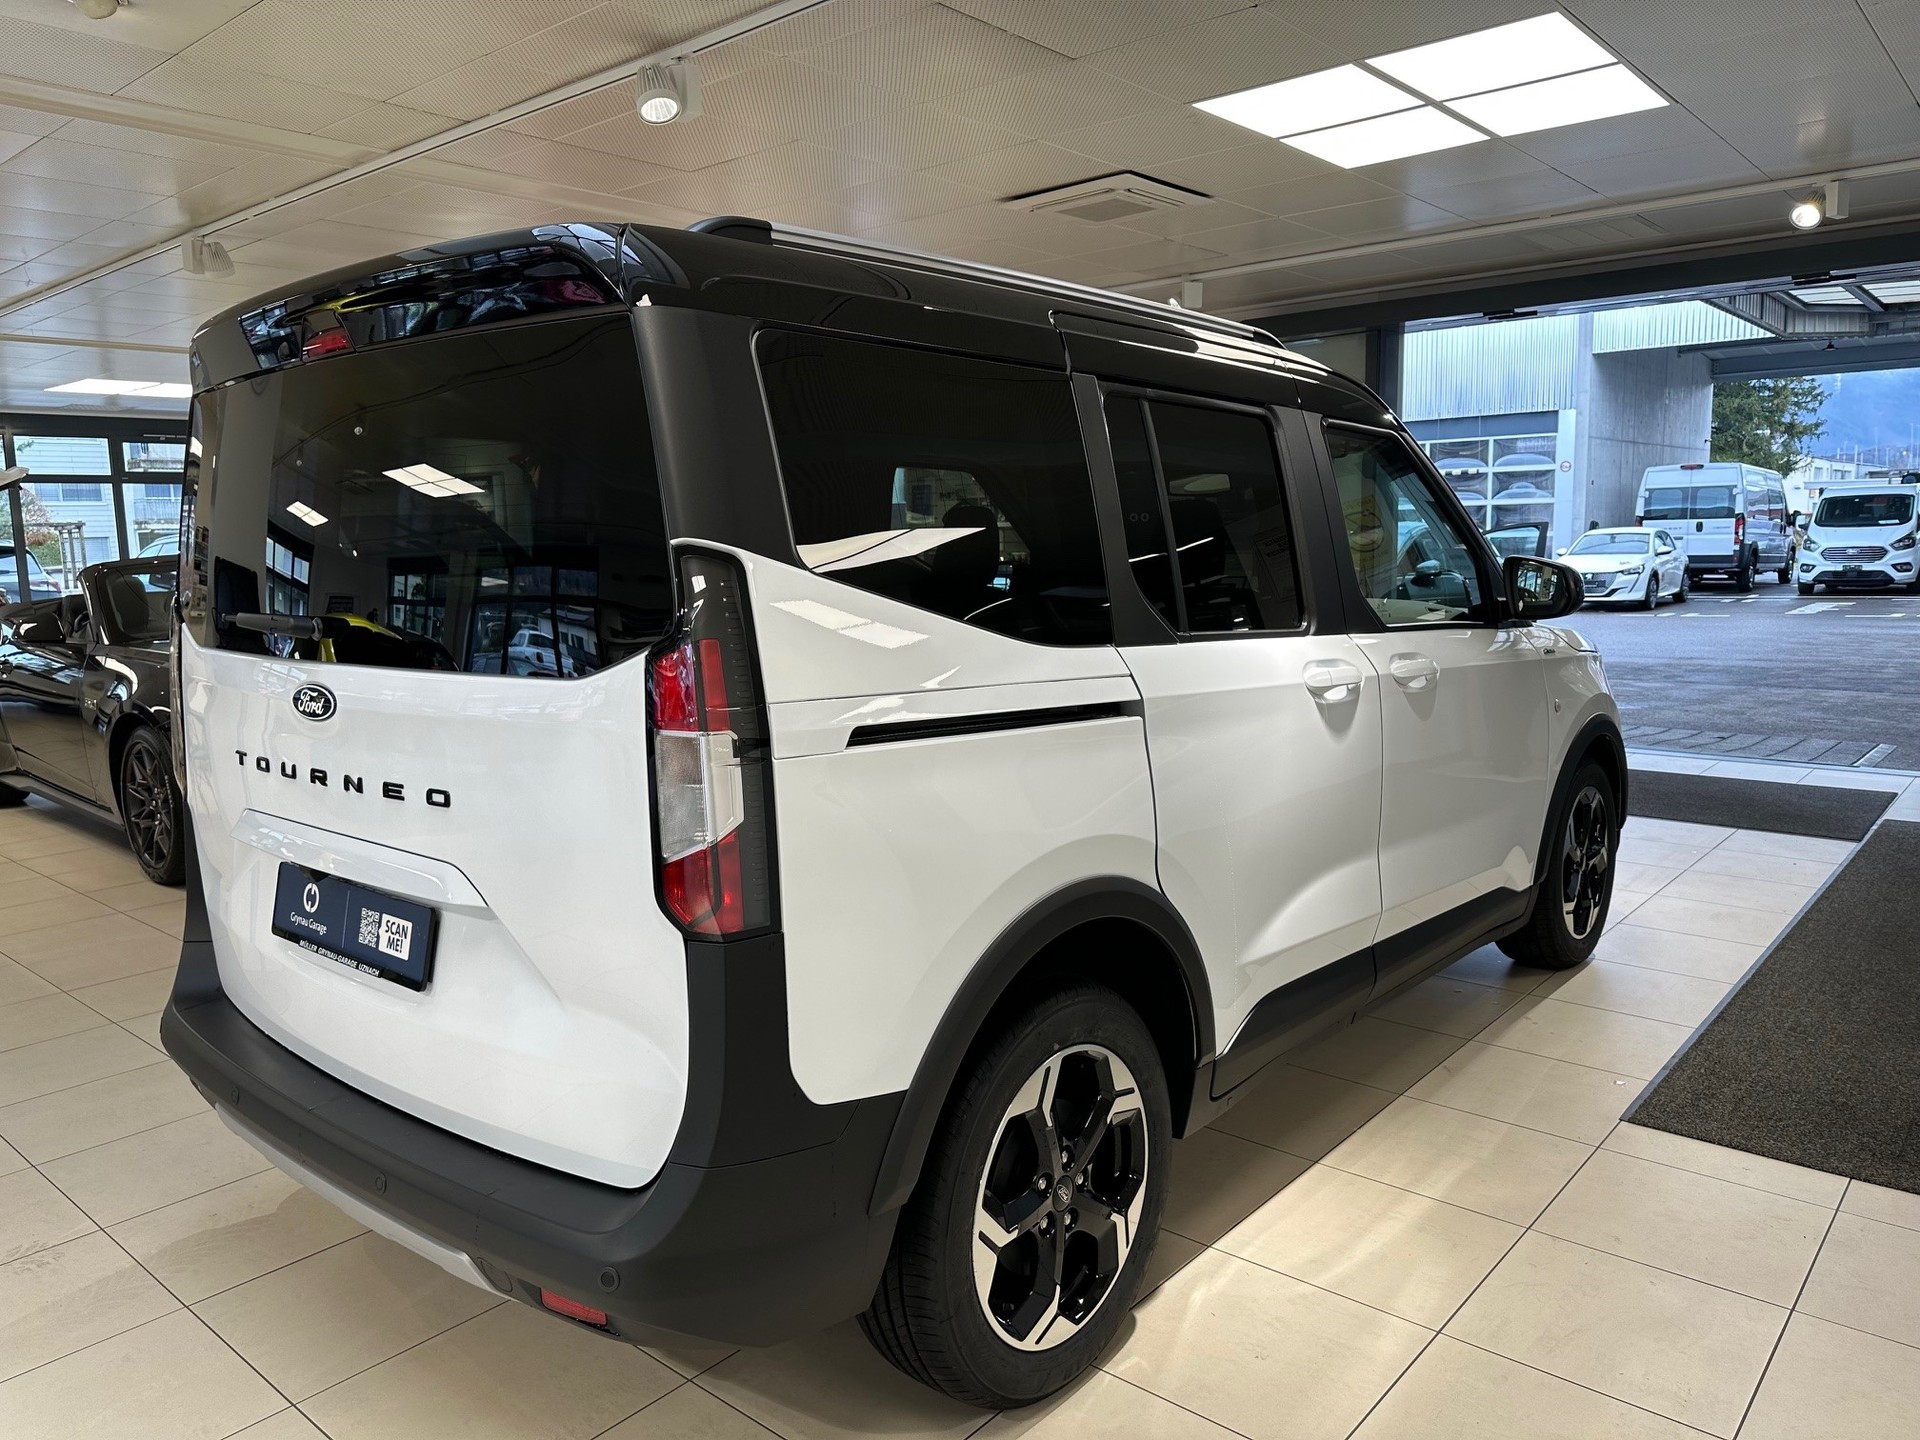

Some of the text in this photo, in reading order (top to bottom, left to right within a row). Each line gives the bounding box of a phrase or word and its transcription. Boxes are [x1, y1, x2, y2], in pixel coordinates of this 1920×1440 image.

[298, 689, 325, 716] Ford
[235, 749, 452, 808] TOURNEO
[290, 911, 328, 934] Grynau Garage
[385, 919, 409, 939] SCAN
[299, 939, 318, 953] MÜLLER
[386, 937, 403, 954] ME!
